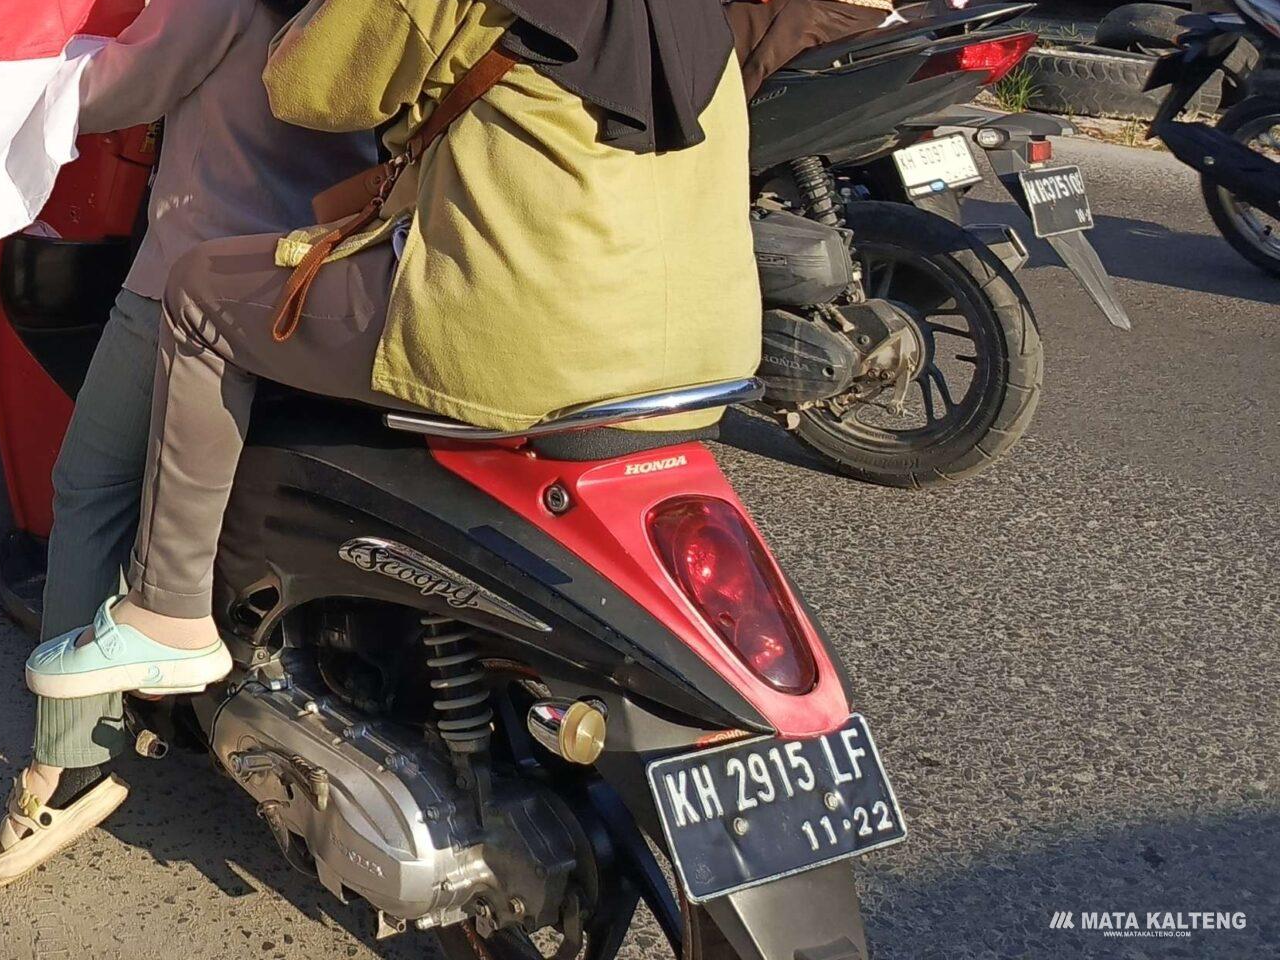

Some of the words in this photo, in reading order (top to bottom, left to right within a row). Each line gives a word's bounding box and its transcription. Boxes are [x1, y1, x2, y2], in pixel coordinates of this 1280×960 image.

[624, 454, 687, 475] HONDA
[346, 542, 479, 609] Scoopy
[665, 764, 724, 827] KH
[727, 741, 816, 812] 2915
[820, 728, 866, 786] LF
